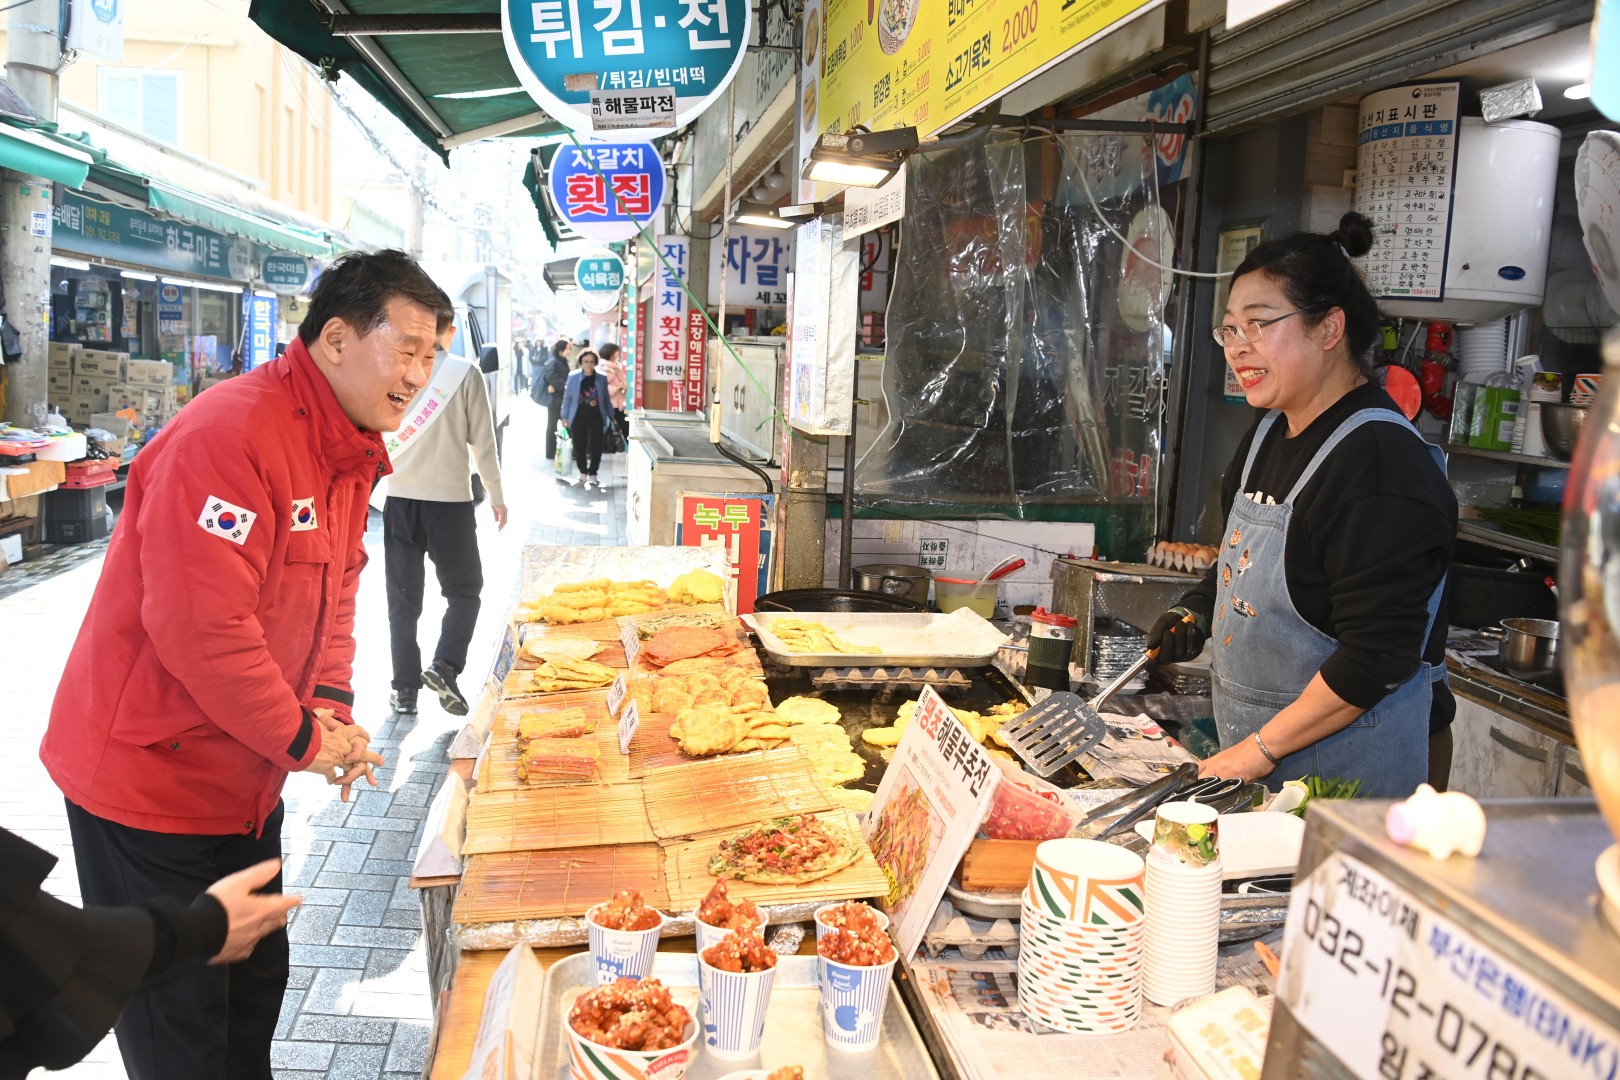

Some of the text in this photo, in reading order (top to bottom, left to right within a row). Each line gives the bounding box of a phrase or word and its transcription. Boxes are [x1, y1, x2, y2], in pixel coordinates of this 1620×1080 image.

[1002, 0, 1039, 53] 2,000
[945, 31, 991, 92] 소고기육전
[605, 95, 674, 115] 해물파전
[1409, 123, 1449, 134] 음식명
[571, 147, 644, 170] 자갈치
[566, 172, 652, 217] 횟집
[582, 272, 620, 287] 식육점
[662, 243, 686, 312] 자갈치
[727, 235, 790, 287] 자갈
[658, 315, 682, 361] 횟집
[688, 313, 704, 408] 포장해드립니다
[656, 365, 683, 376] 자연산
[693, 503, 750, 531] 녹두
